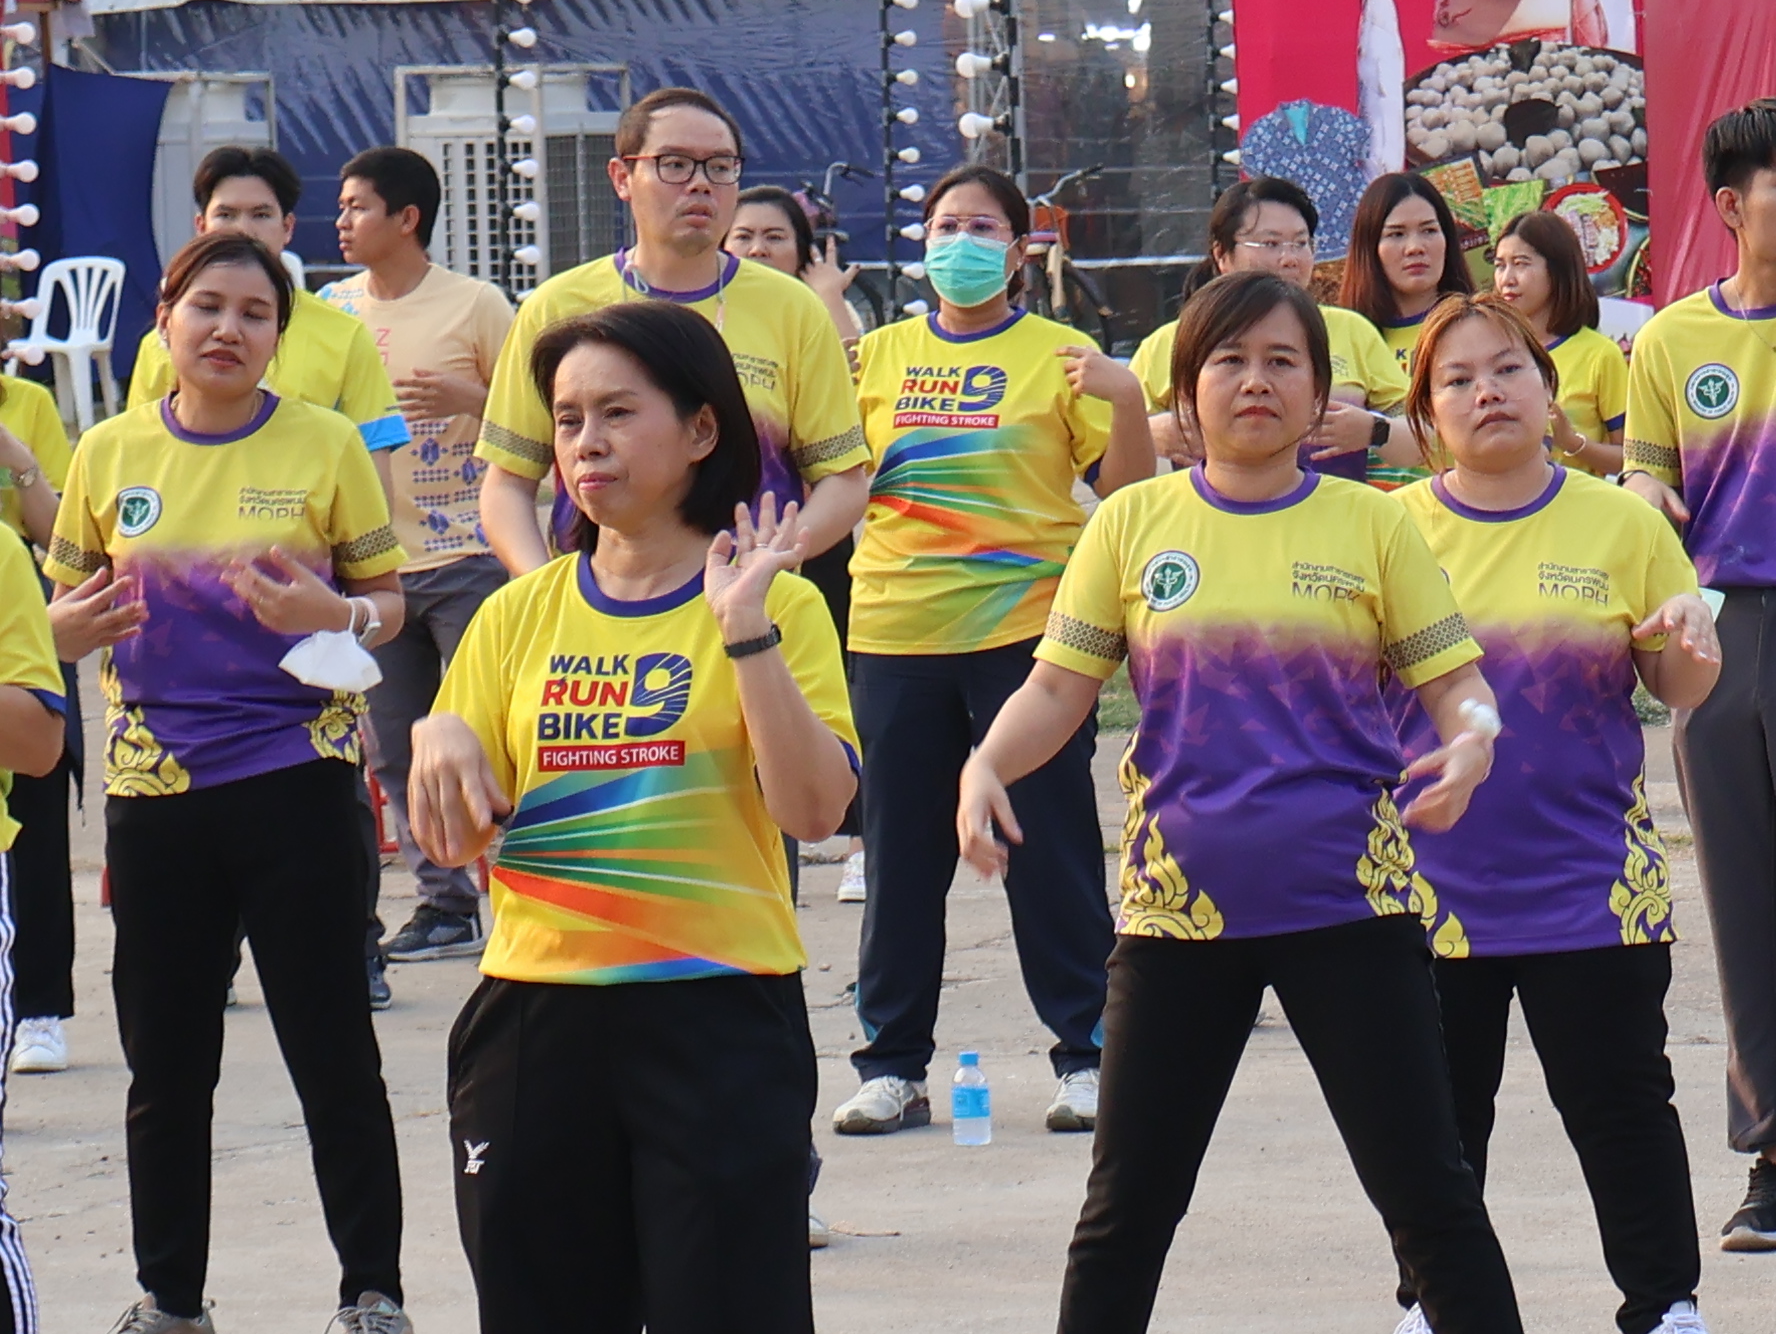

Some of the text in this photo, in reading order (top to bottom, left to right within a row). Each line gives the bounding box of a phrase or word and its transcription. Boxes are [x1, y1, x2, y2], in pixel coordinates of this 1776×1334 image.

[906, 366, 962, 377] WALK
[900, 378, 960, 395] RUN
[894, 396, 956, 411] BIKE
[1538, 582, 1609, 608] MOPH
[550, 654, 630, 676] WALK
[541, 677, 629, 707] RUN
[538, 712, 623, 741] BIKE
[543, 746, 679, 767] FIGHTING STROKE
